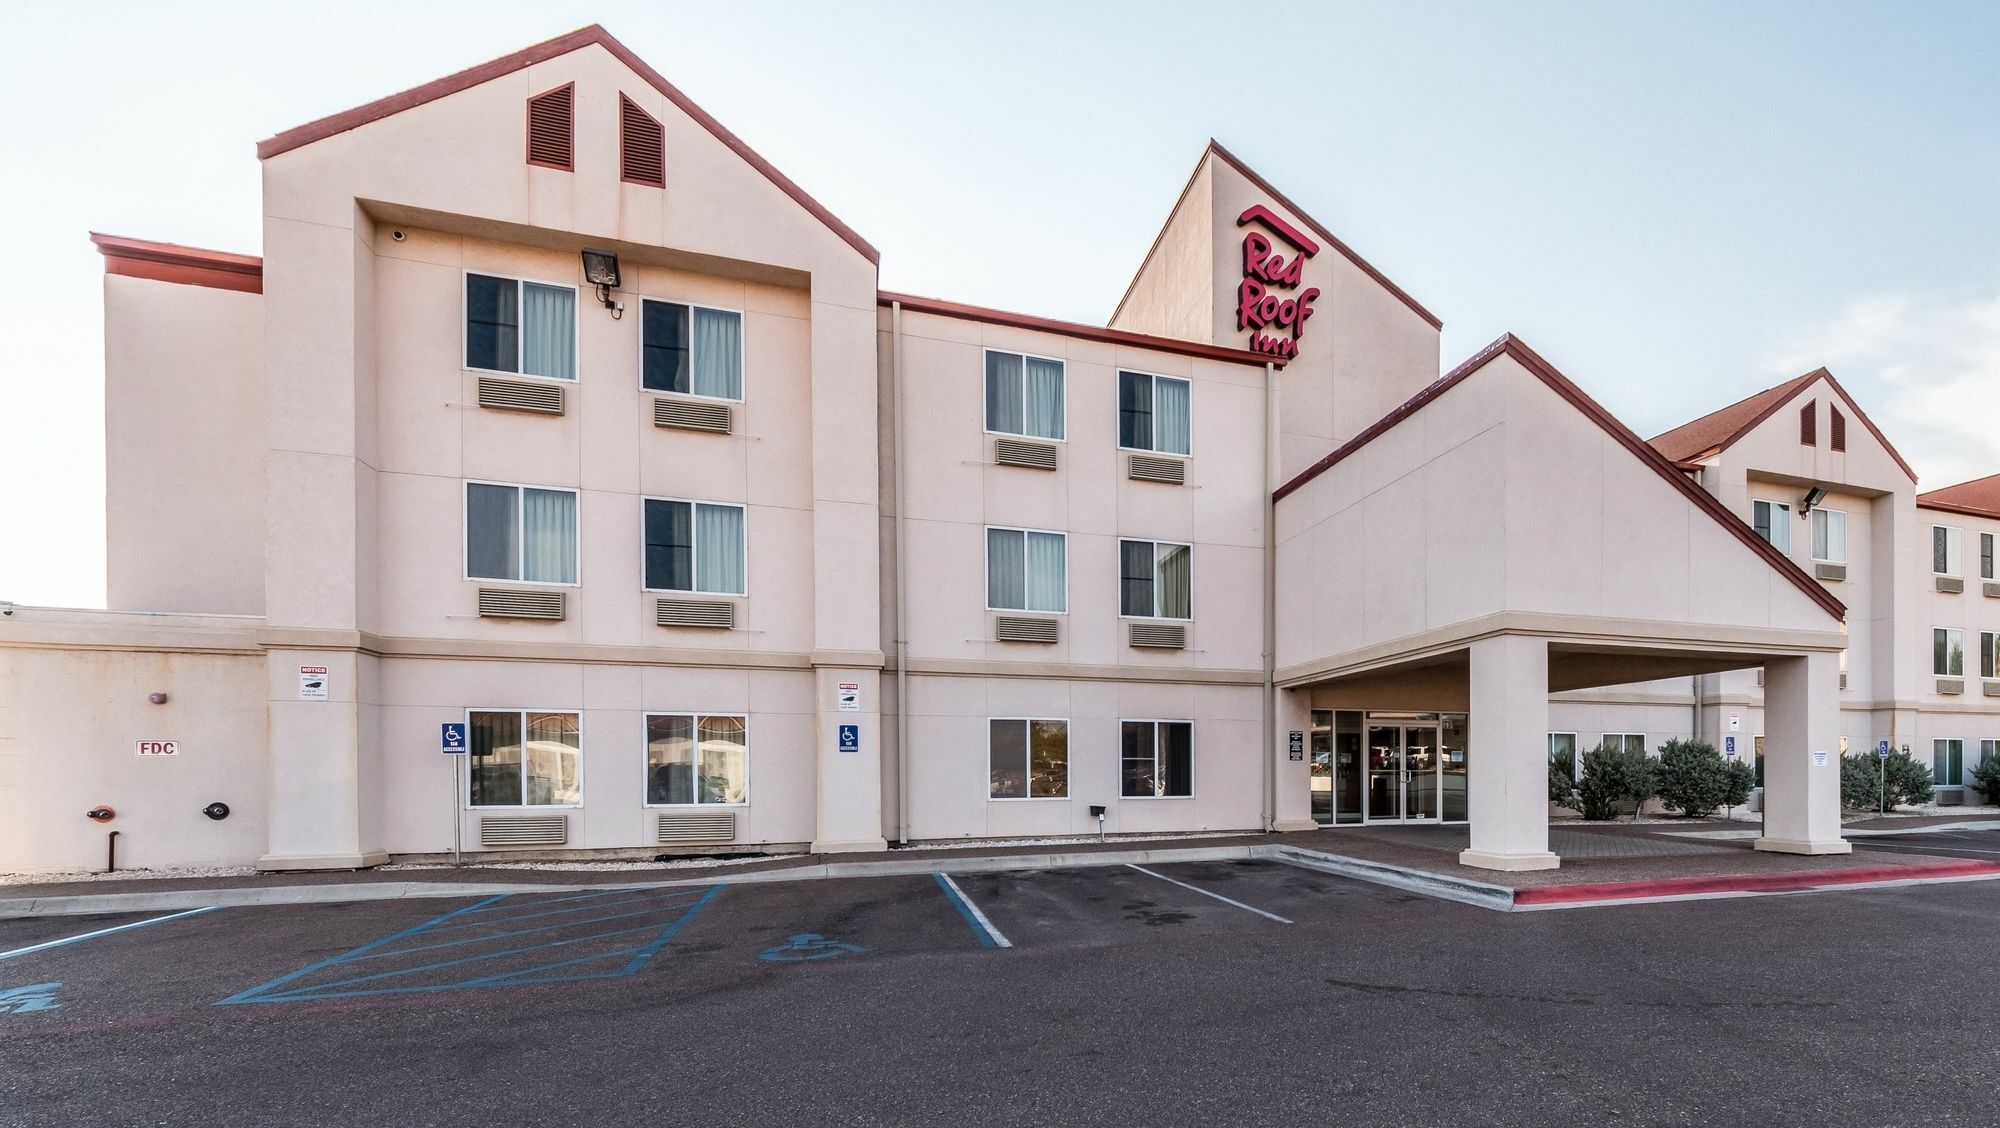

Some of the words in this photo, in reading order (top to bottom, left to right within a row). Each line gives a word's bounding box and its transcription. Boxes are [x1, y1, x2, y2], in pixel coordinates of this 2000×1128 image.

[1243, 232, 1305, 289] Red
[1237, 278, 1320, 337] Roof
[140, 743, 174, 755] FDC
